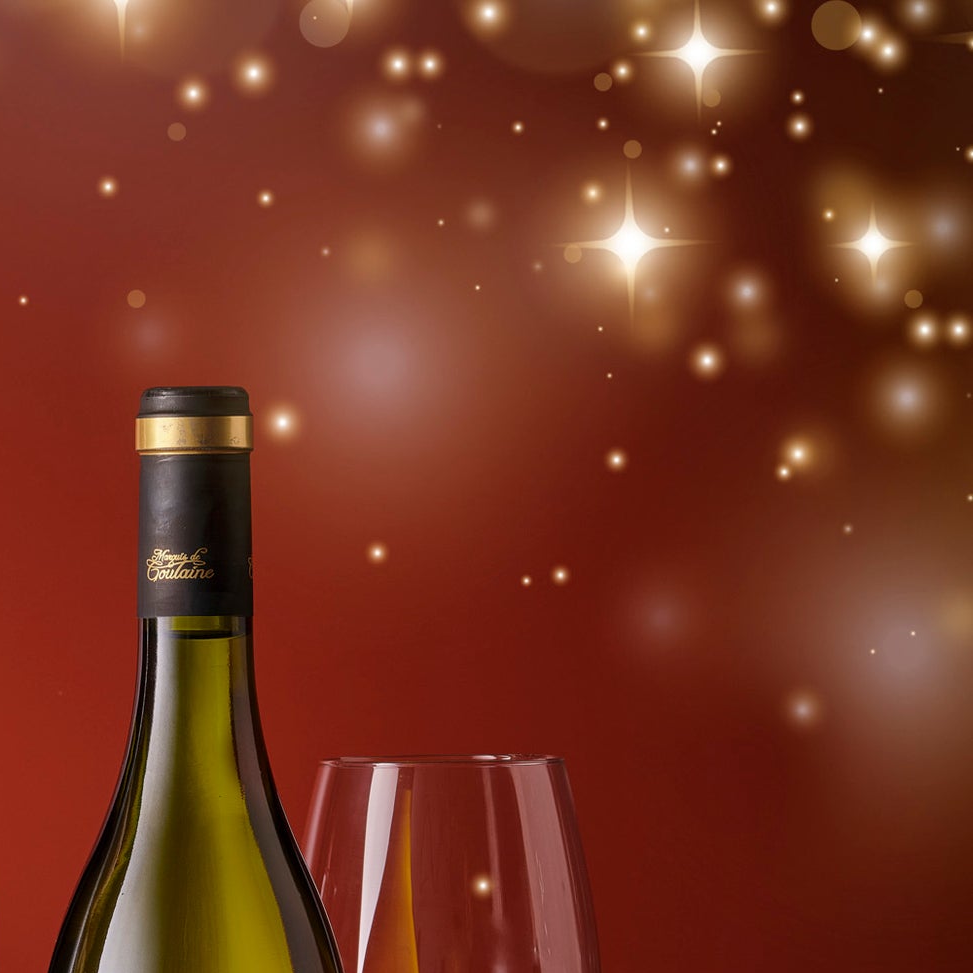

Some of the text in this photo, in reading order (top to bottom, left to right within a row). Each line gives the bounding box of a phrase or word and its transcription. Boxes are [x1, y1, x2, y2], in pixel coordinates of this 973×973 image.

[151, 547, 208, 566] Marquis de
[146, 558, 215, 582] Goulaine
